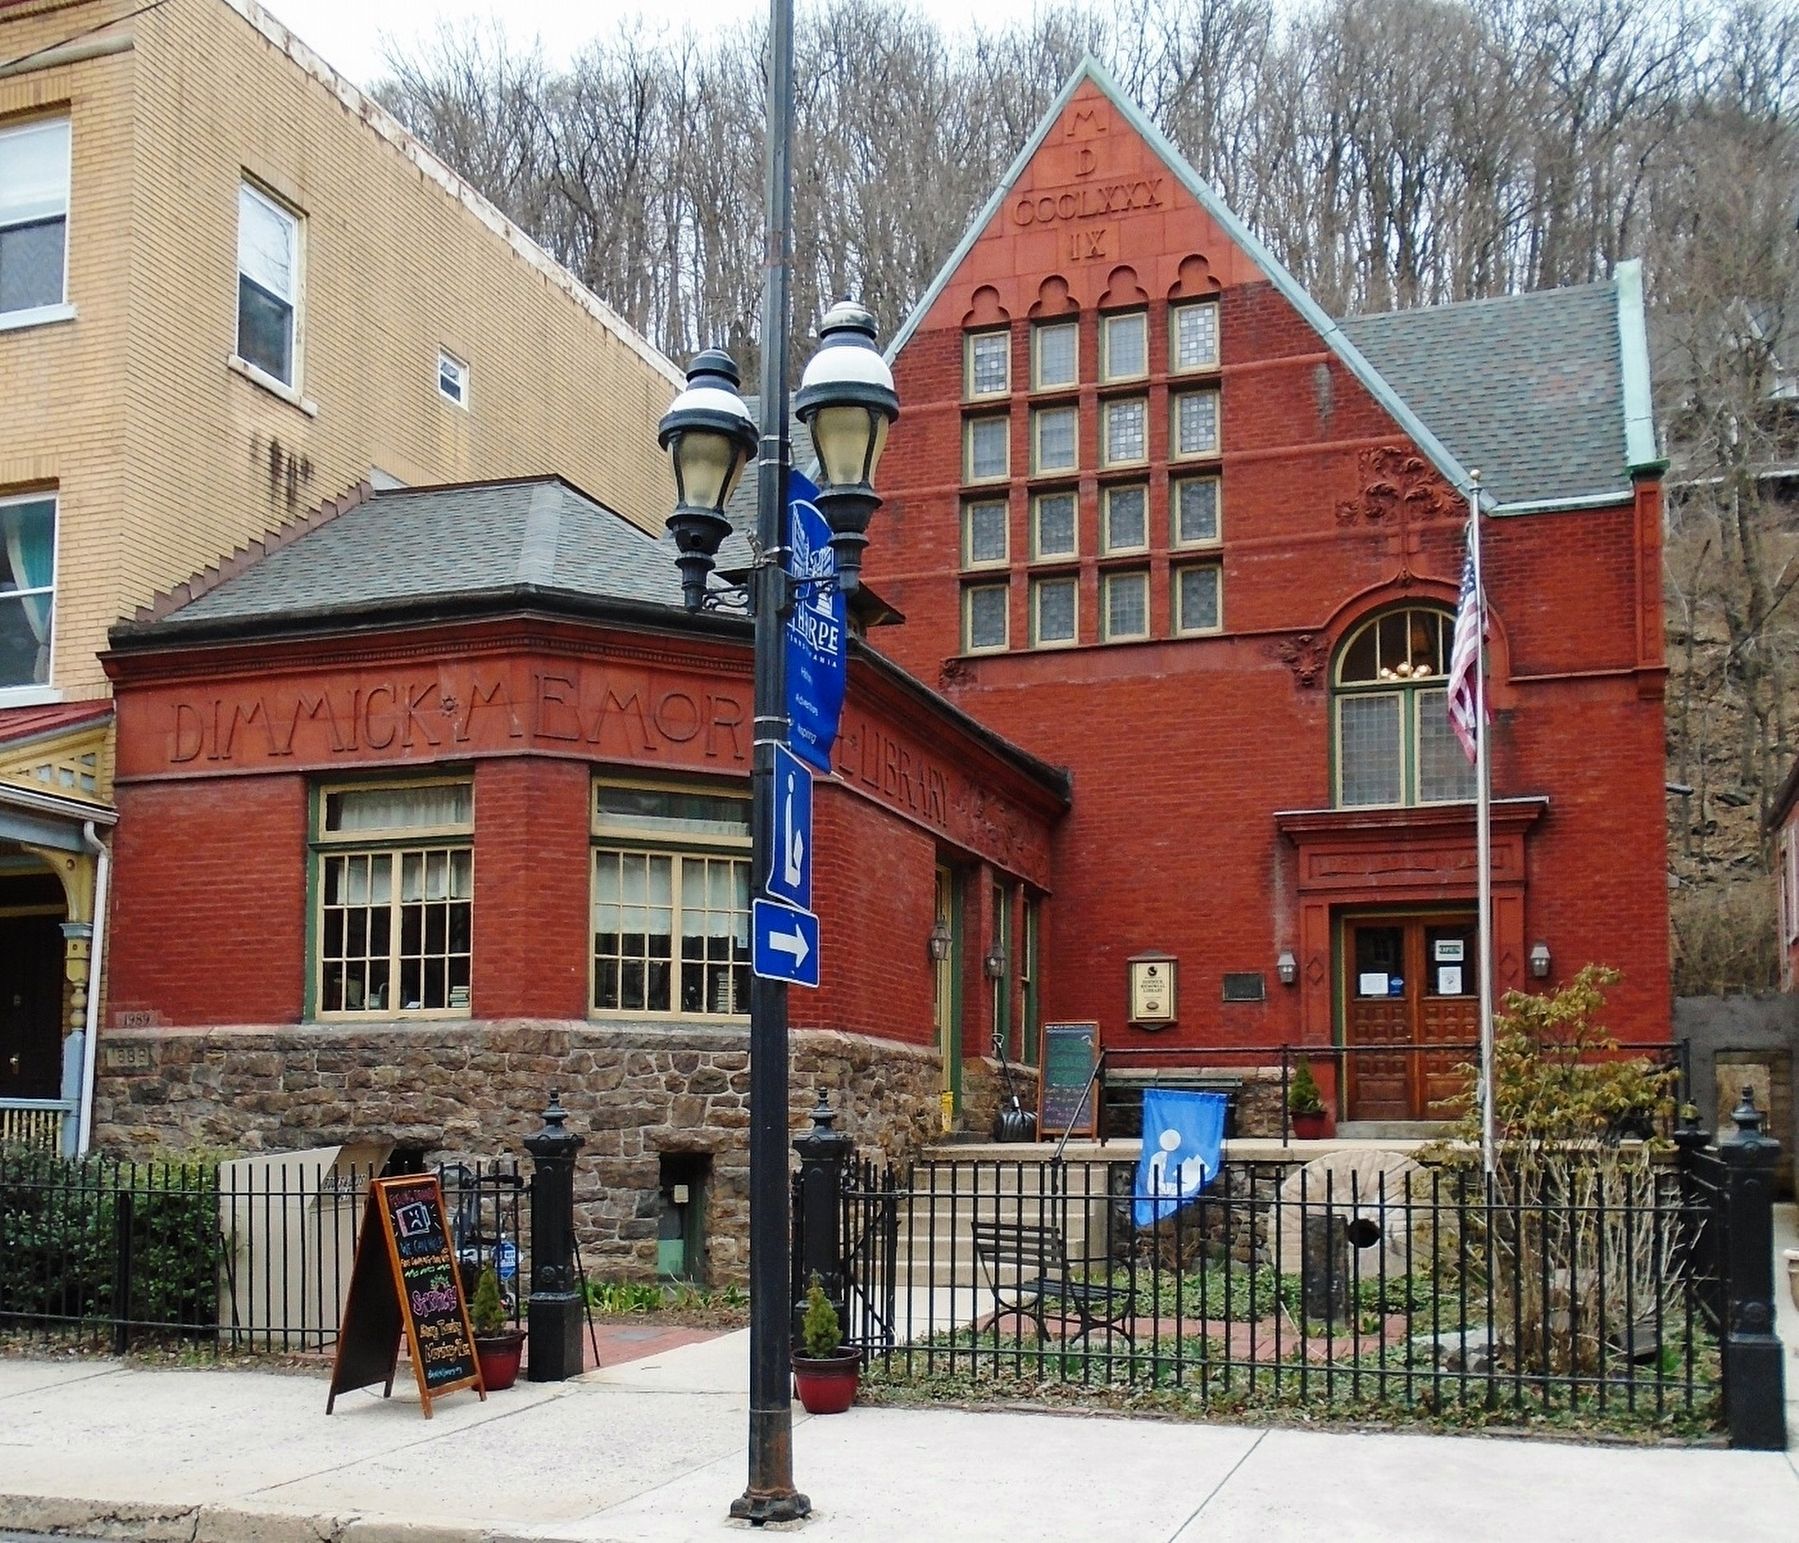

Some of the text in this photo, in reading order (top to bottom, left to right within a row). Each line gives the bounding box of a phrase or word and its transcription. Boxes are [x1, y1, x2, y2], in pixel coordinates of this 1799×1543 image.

[1066, 109, 1106, 137] M
[1075, 149, 1098, 177] D
[1013, 178, 1163, 227] CCCLXXX
[1069, 229, 1107, 261] IX
[791, 599, 839, 652] THRPE
[170, 681, 442, 765] DIMMICK
[861, 724, 949, 828] LIBRARY
[123, 1013, 151, 1027] 1989
